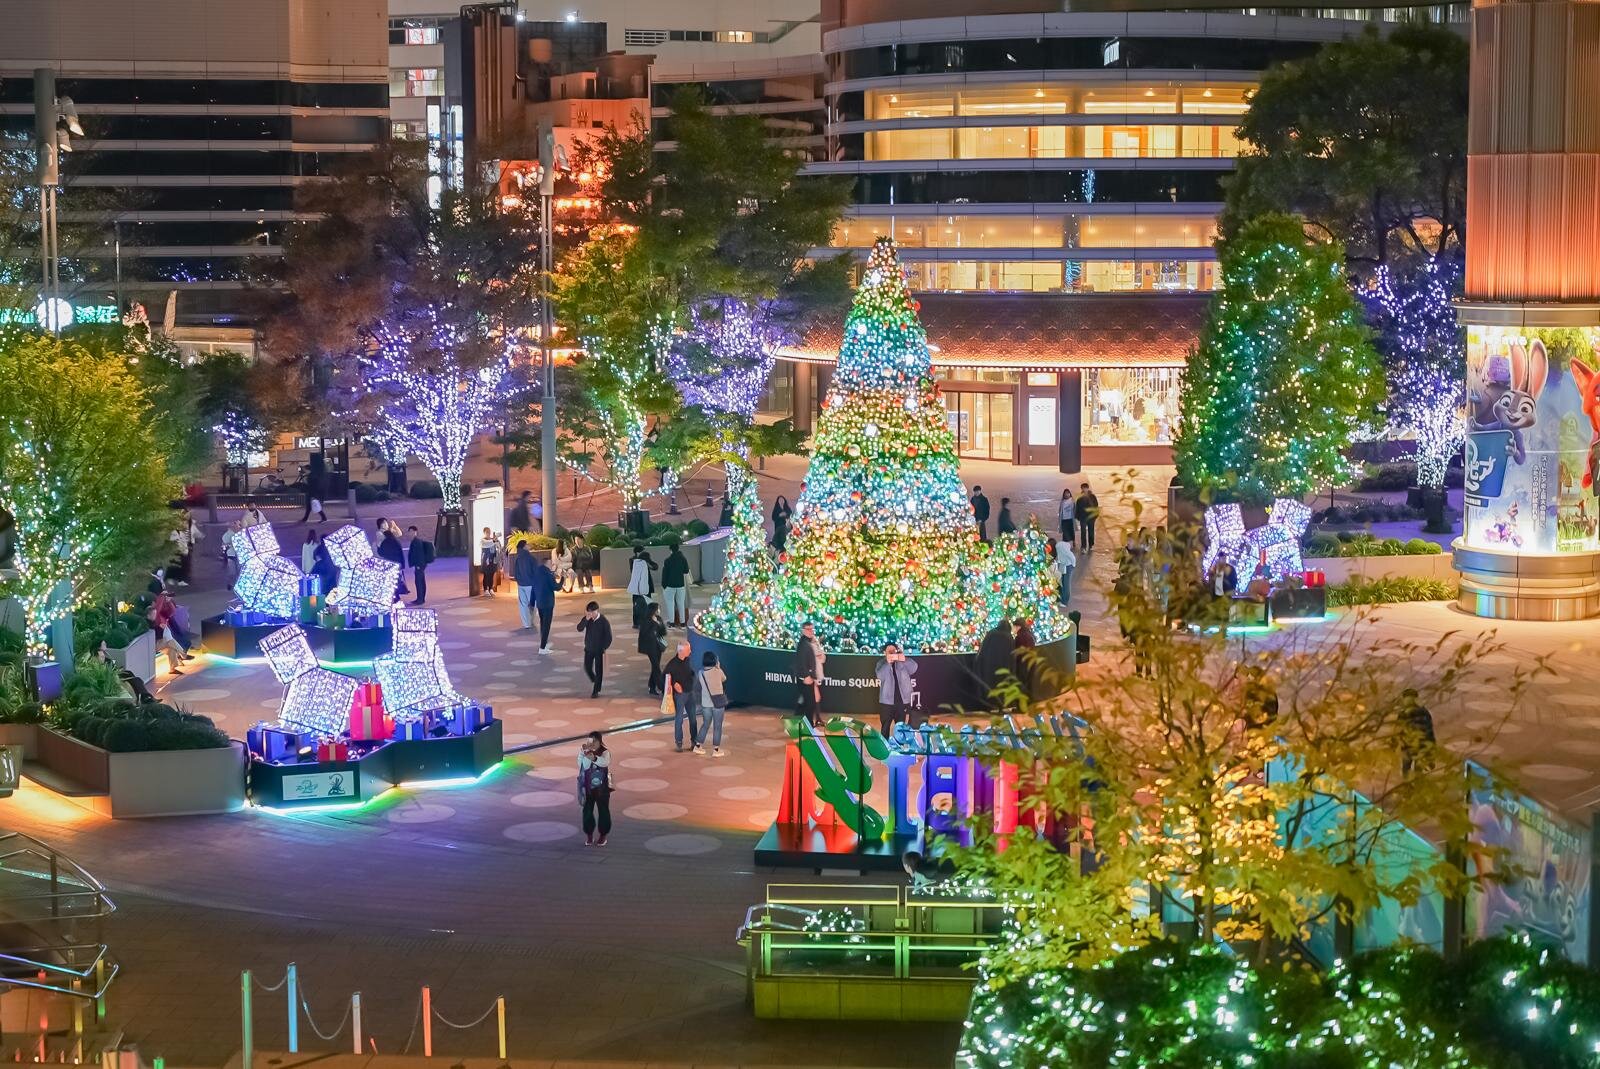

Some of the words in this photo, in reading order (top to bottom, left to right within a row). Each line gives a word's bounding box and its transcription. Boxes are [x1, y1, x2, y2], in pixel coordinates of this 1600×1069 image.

[765, 671, 792, 684] HIBIYA
[824, 677, 846, 687] Time
[848, 679, 881, 688] SQUAR
